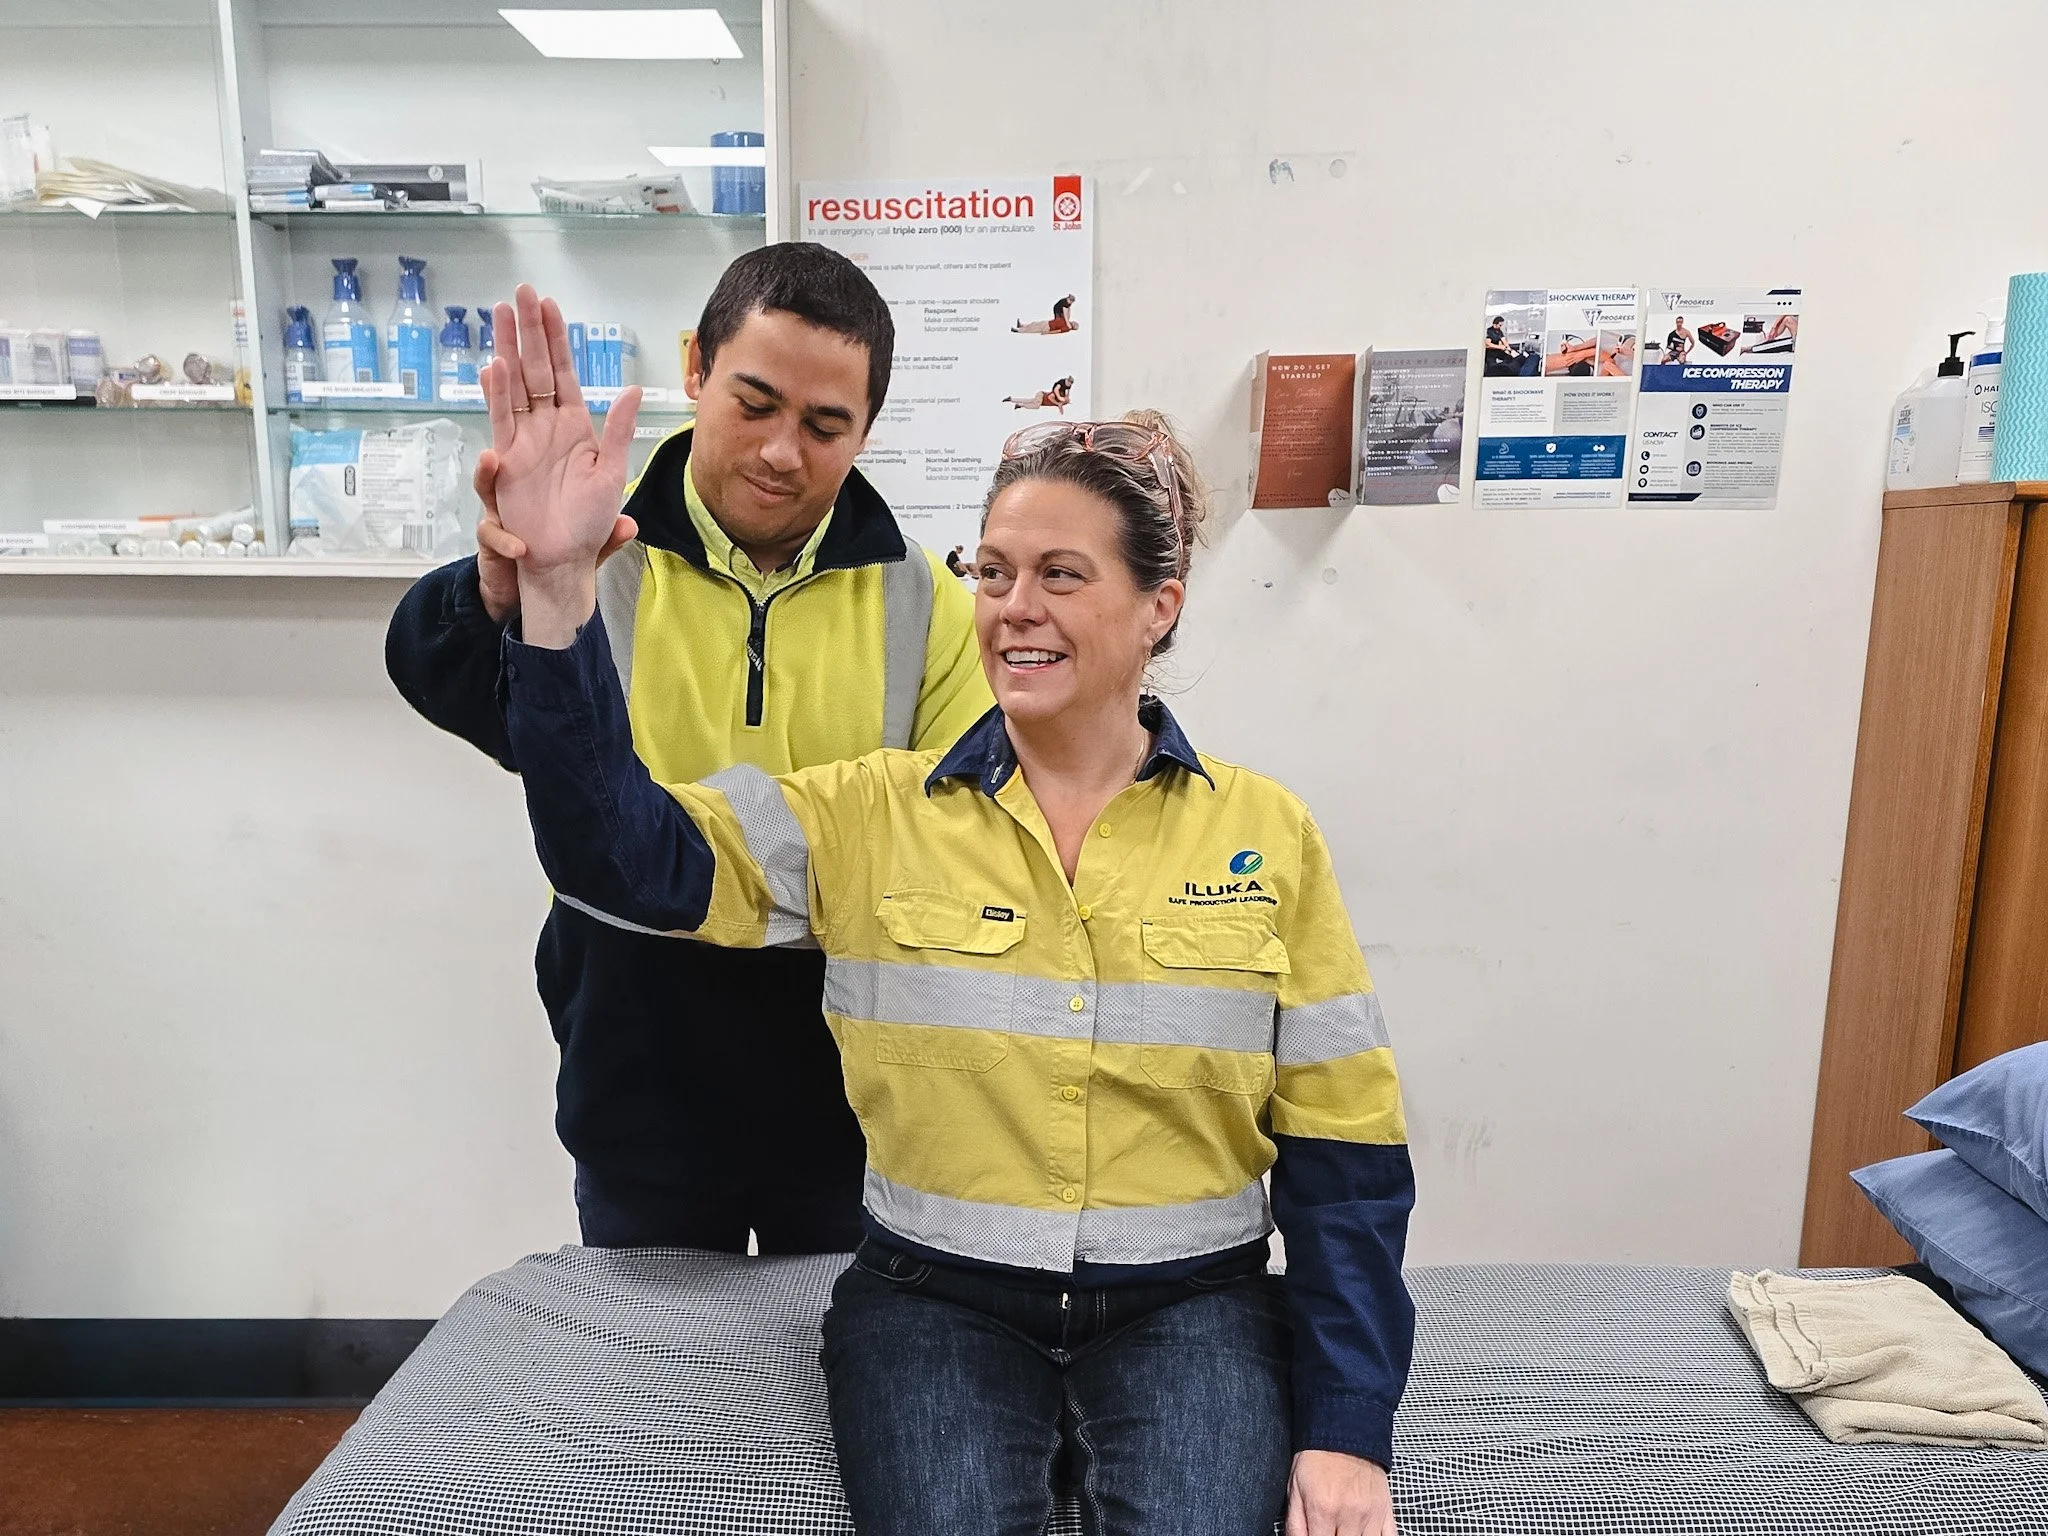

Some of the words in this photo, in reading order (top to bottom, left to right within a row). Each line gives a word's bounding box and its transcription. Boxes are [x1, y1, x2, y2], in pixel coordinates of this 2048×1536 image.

[808, 189, 1034, 222] resuscitation
[820, 228, 829, 236] an
[830, 227, 875, 237] emergency
[877, 225, 890, 235] call
[893, 225, 916, 236] triple
[918, 226, 938, 235] zero
[940, 224, 962, 236] (000)
[964, 224, 975, 234] for
[977, 225, 988, 234] an
[989, 223, 1035, 233] ambulance
[1053, 222, 1061, 231] St
[1063, 220, 1082, 231] John
[989, 262, 1012, 270] patient
[1549, 293, 1600, 302] SHOCKWAVE
[1601, 293, 1636, 301] THERAPY
[924, 307, 957, 315] Response
[1293, 363, 1306, 371] DO
[1280, 372, 1322, 380] STARTED?
[1682, 367, 1702, 379] ICE
[1702, 367, 1785, 379] COMPRESSION
[1730, 379, 1784, 390] THERAPY
[950, 474, 980, 482] breathing
[906, 503, 951, 511] compressions
[1184, 879, 1265, 897] ILUKA
[1168, 896, 1187, 905] SAFE
[1189, 896, 1238, 906] PRODUCTION
[985, 908, 1011, 920] Bisley
